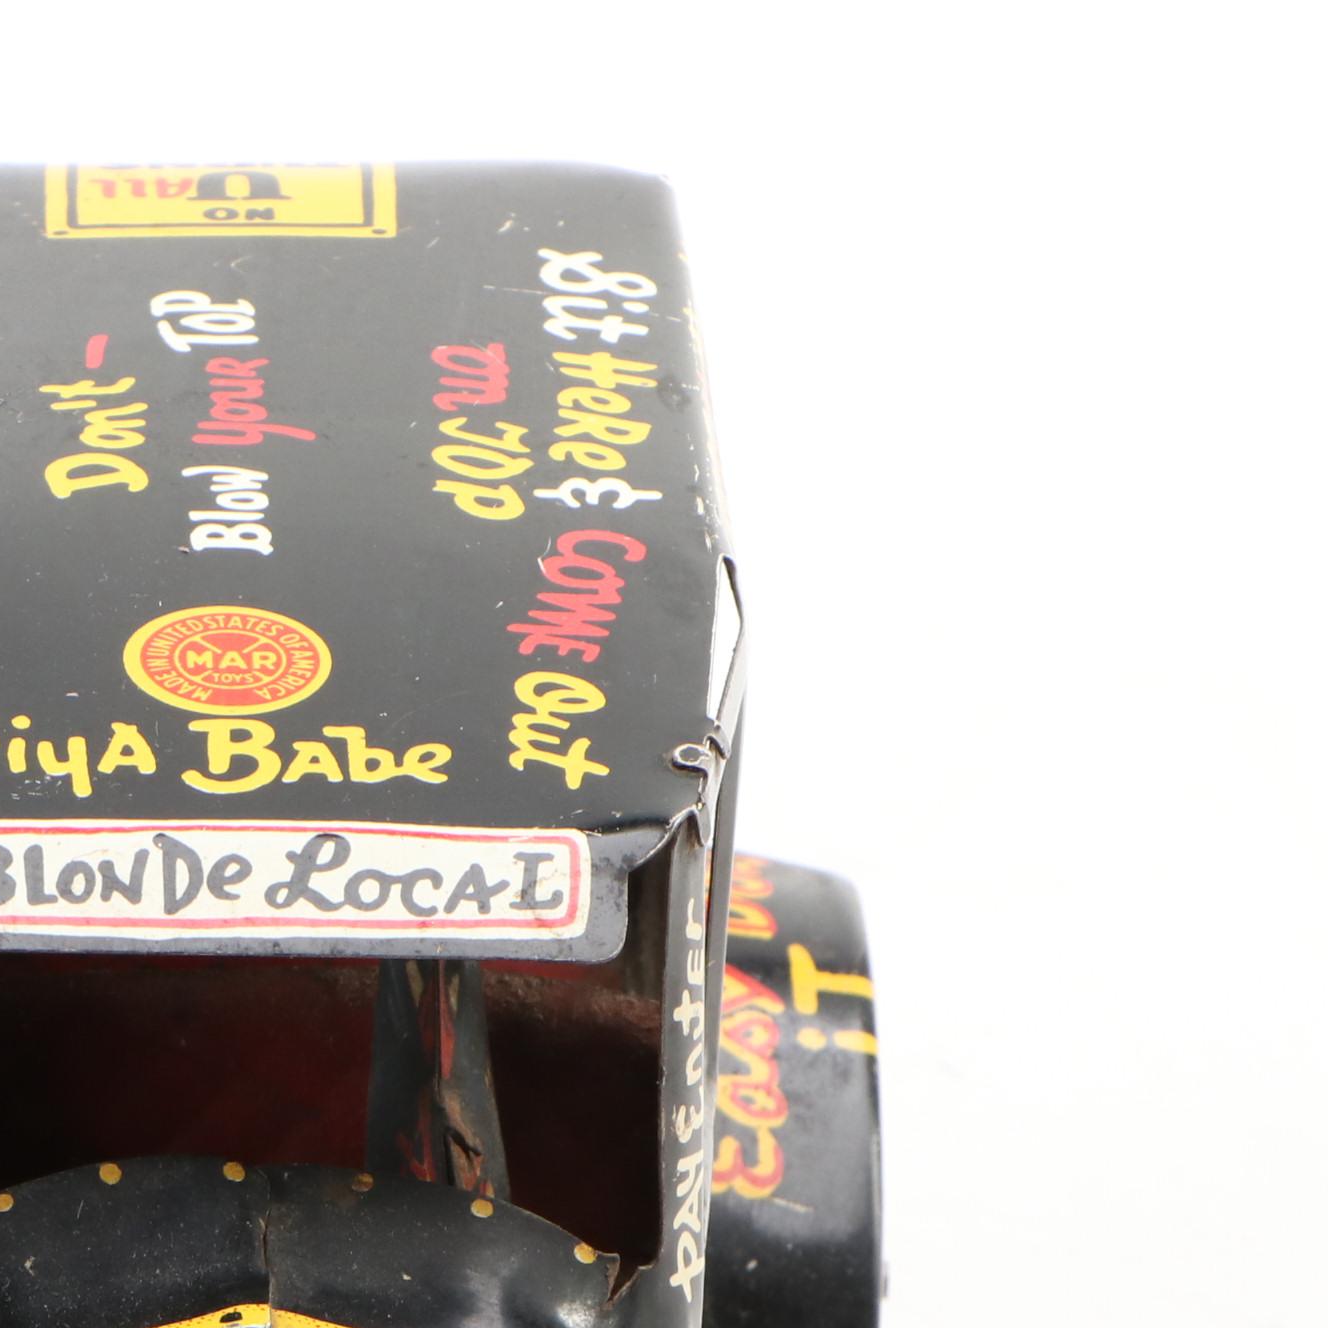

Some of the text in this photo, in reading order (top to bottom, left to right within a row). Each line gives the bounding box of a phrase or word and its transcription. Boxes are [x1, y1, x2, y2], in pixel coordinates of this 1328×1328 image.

[537, 247, 659, 343] Sit
[181, 465, 274, 556] Blow
[533, 476, 664, 510] &
[146, 615, 316, 701] MADE IN UNITED STATES OF AMERICA
[185, 650, 278, 670] MAR
[213, 671, 255, 684] TOYS
[508, 670, 610, 790] Out
